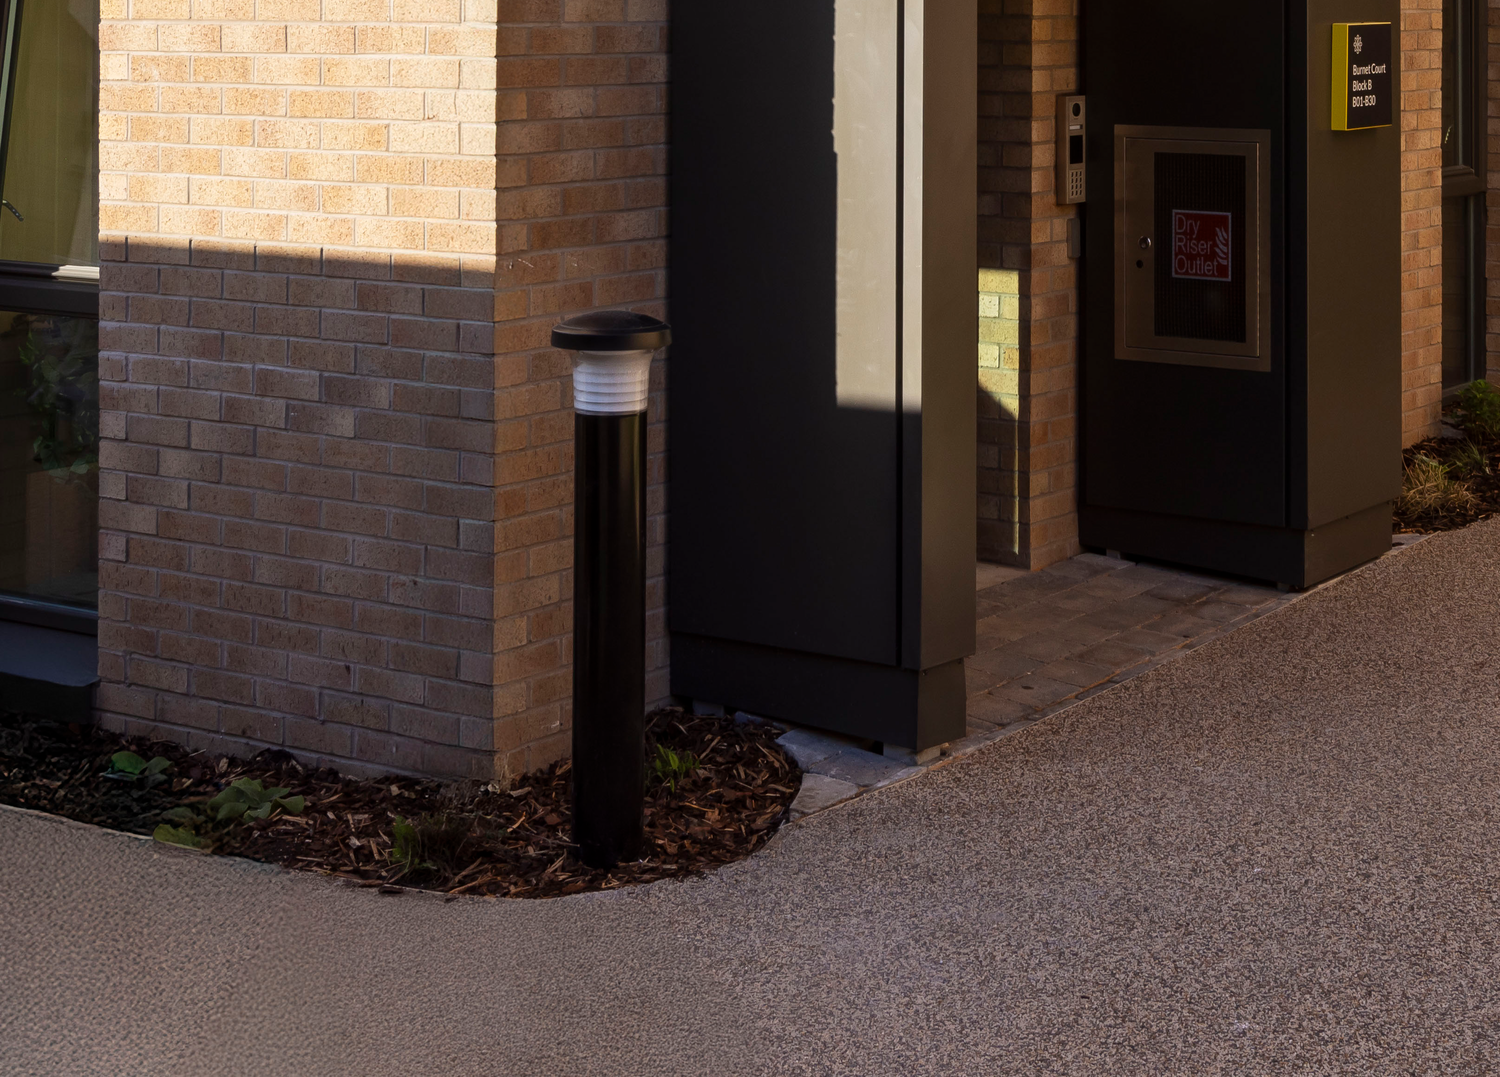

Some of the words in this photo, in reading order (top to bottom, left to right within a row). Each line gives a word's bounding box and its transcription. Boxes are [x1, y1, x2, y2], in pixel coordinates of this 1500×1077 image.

[1353, 64, 1370, 75] Burnet
[1371, 63, 1386, 74] Court
[1353, 80, 1367, 91] Block
[1368, 79, 1372, 90] B
[1353, 95, 1376, 107] B01-B30
[1176, 215, 1200, 238] Dry
[1176, 235, 1212, 254] Riser
[1176, 255, 1217, 276] Outlet
